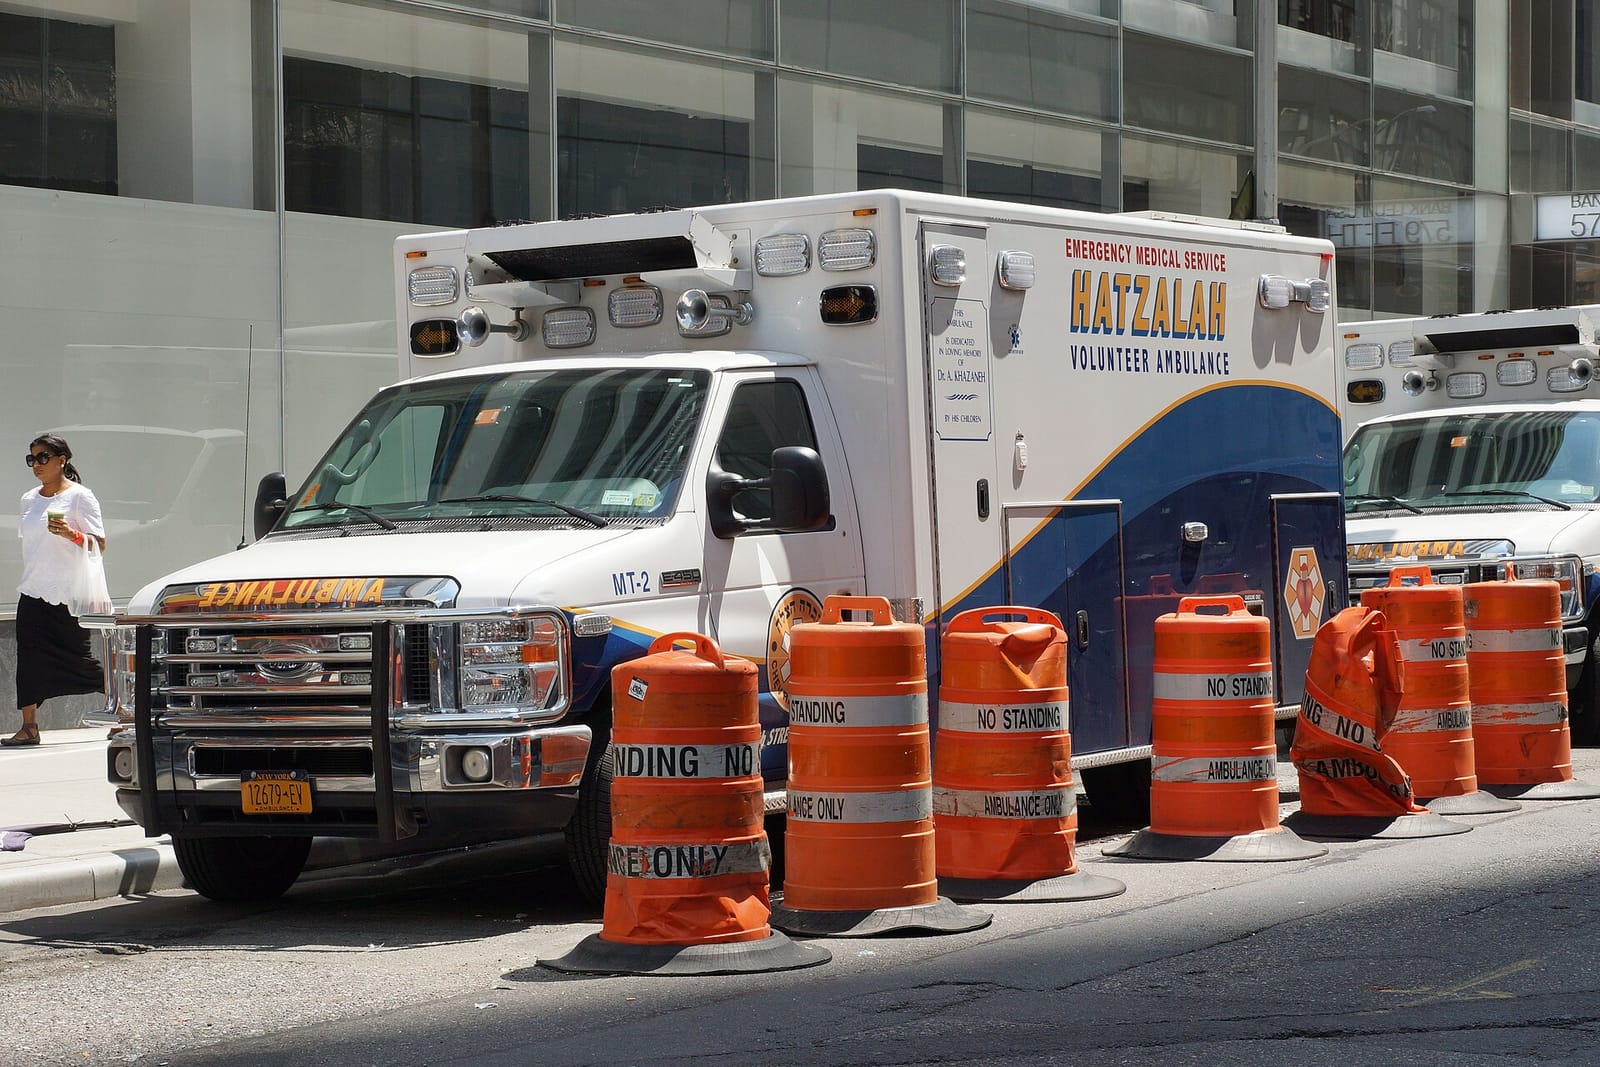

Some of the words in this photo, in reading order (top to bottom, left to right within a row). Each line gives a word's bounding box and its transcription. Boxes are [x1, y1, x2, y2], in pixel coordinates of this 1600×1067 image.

[1065, 238, 1132, 264] EMERGENCY
[1136, 245, 1181, 269] MEDICAL
[1184, 250, 1227, 272] SERVICE
[954, 308, 964, 317] THIS
[1070, 269, 1227, 341] HATZALAH
[946, 319, 974, 328] AMBULANCE
[939, 347, 945, 355] IN
[945, 348, 962, 357] LOVING
[963, 349, 982, 357] MEMORY
[945, 337, 950, 345] IS
[951, 337, 975, 346] DEDICATED
[957, 359, 964, 367] OF
[1070, 345, 1149, 373] VOLUNTEER
[1156, 349, 1229, 375] AMBULANCE
[954, 370, 986, 383] KHAZANEH
[944, 414, 950, 423] BY
[951, 415, 960, 423] HIS
[960, 415, 982, 423] CHILDREN
[612, 572, 650, 595] MT-2
[1432, 641, 1446, 658] NO
[1207, 678, 1227, 697] NO
[791, 699, 845, 723] STANDING
[977, 709, 997, 730] NO
[1003, 706, 1060, 730] STANDING
[1335, 716, 1365, 744] NO
[725, 744, 752, 777] NO
[1208, 759, 1262, 780] AMBULANCE
[817, 797, 845, 820] ONLY
[985, 795, 1040, 816] AMBULANCE
[653, 846, 728, 878] ONLY
